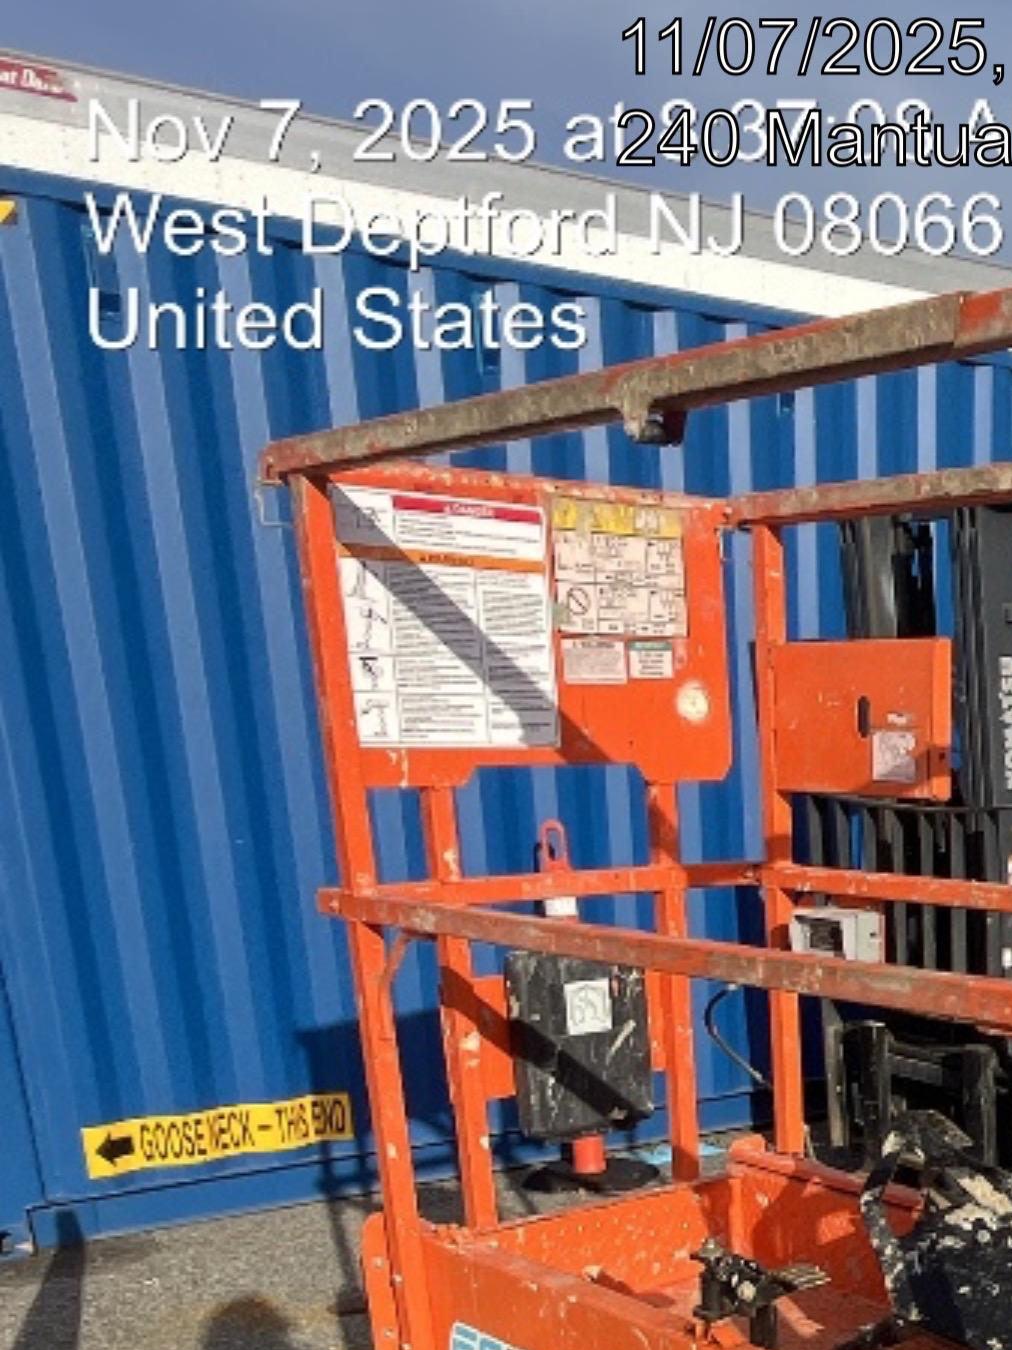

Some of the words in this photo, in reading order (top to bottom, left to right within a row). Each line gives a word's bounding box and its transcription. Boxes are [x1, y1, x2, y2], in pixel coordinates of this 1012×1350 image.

[139, 1108, 256, 1161] GOOSENECK
[275, 1103, 310, 1144] THIS
[311, 1099, 346, 1136] END
